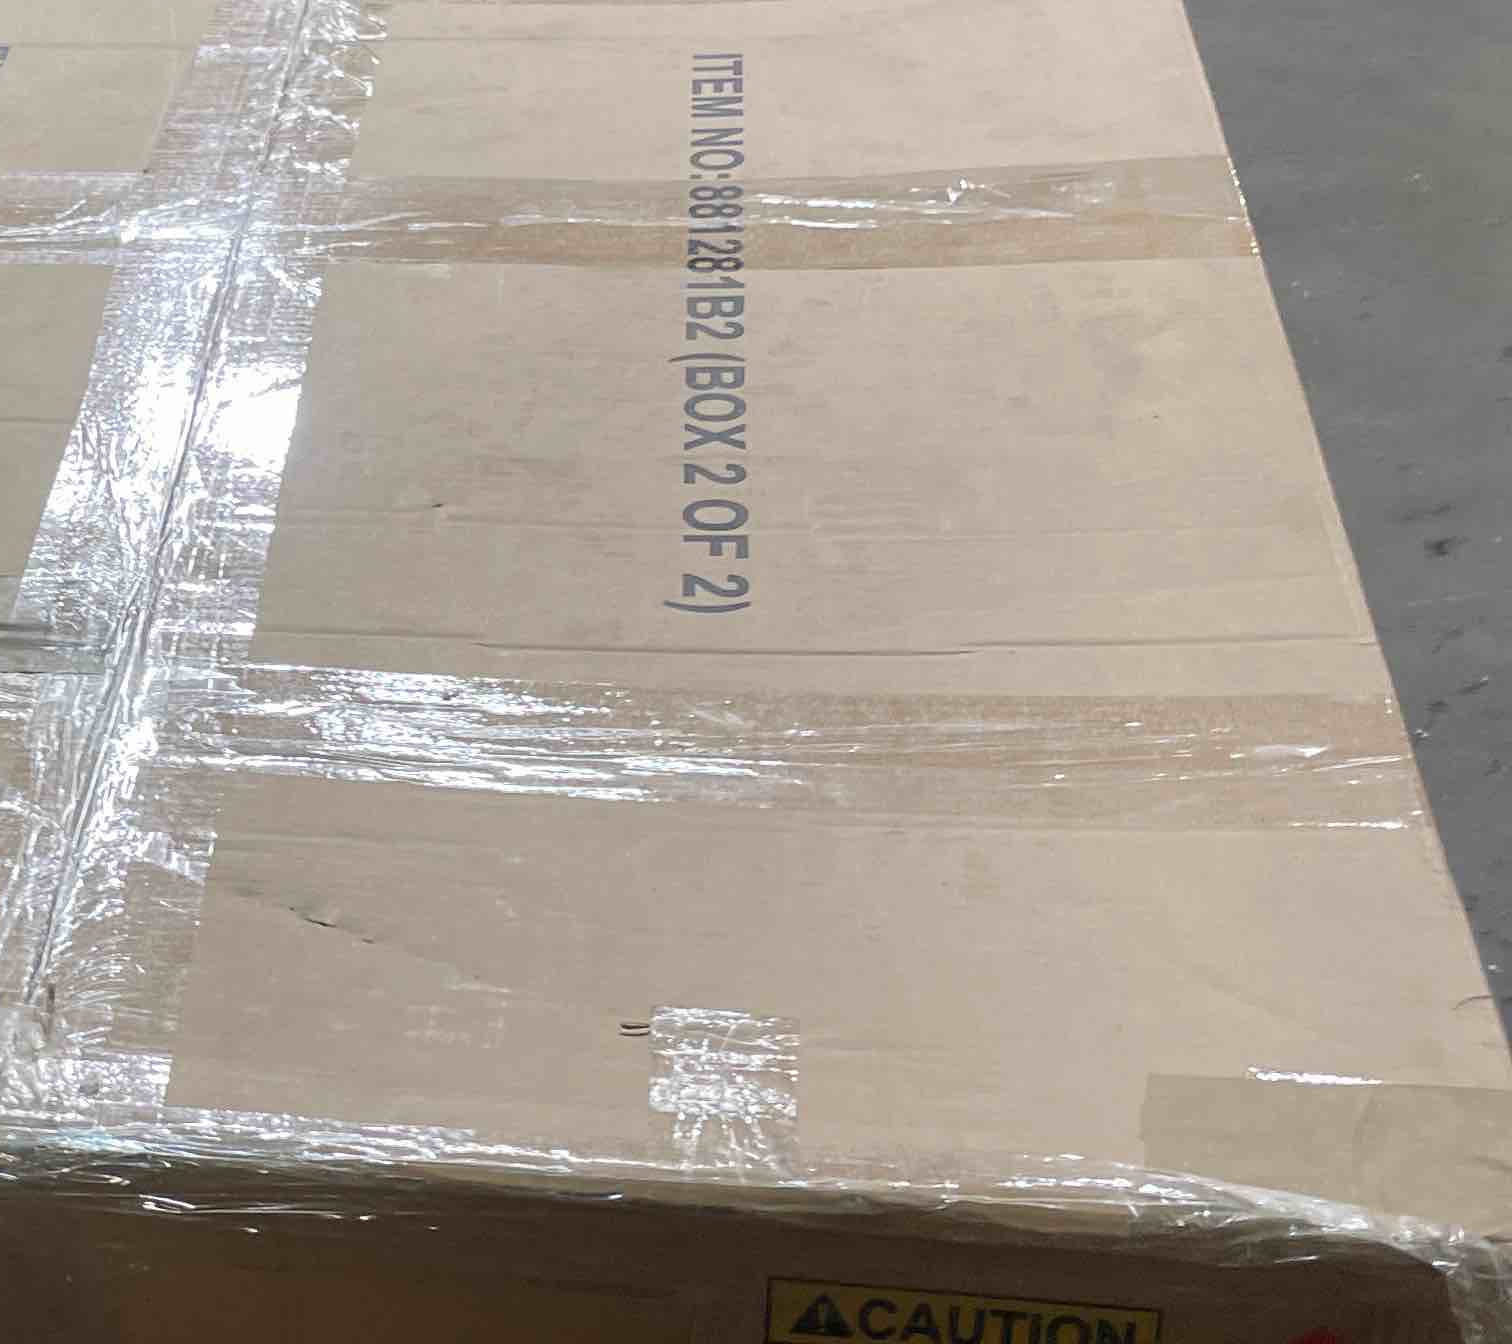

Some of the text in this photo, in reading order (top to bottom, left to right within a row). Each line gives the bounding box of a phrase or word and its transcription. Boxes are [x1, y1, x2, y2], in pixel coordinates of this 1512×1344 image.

[691, 52, 744, 119] ITEM
[668, 352, 747, 452] (BOX
[683, 462, 748, 486] 2
[681, 498, 750, 560] OF
[662, 573, 752, 615] 2)
